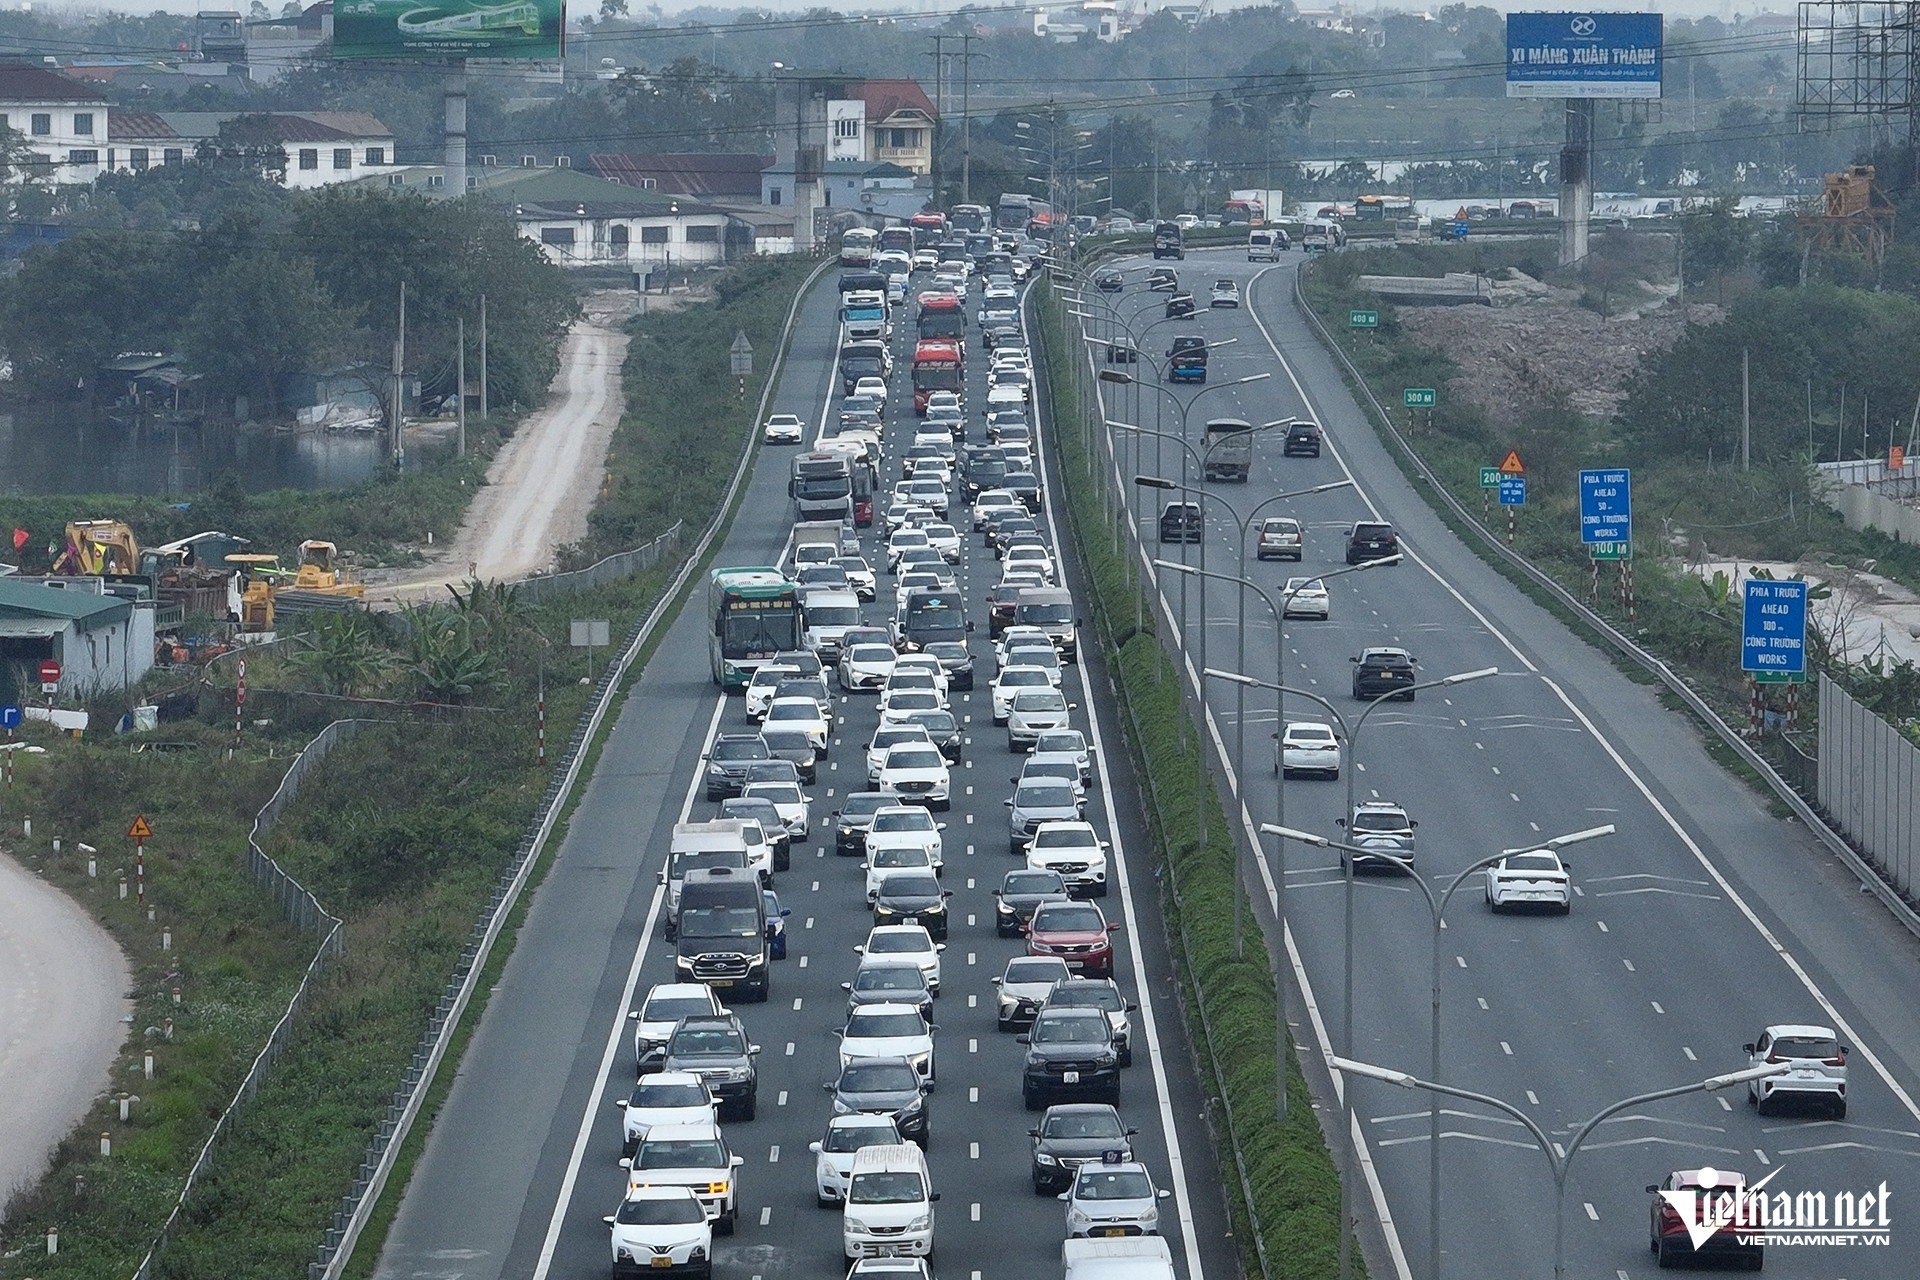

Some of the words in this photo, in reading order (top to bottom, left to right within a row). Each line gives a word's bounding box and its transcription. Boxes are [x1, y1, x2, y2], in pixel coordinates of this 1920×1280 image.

[1512, 48, 1525, 64] XI
[1529, 44, 1568, 64] MĂNG
[1572, 44, 1609, 64] XUÂN
[1613, 44, 1655, 65] THÀNH
[1352, 314, 1366, 323] 400
[1407, 393, 1422, 402] 300
[1483, 472, 1501, 483] 200
[1593, 488, 1617, 497] AHEAD
[1594, 528, 1618, 537] WORKS
[1595, 543, 1613, 554] 100
[1761, 604, 1789, 614] AHEAD
[1763, 621, 1776, 631] 100
[1745, 634, 1767, 647] CÔNG
[1758, 654, 1787, 665] WORKS
